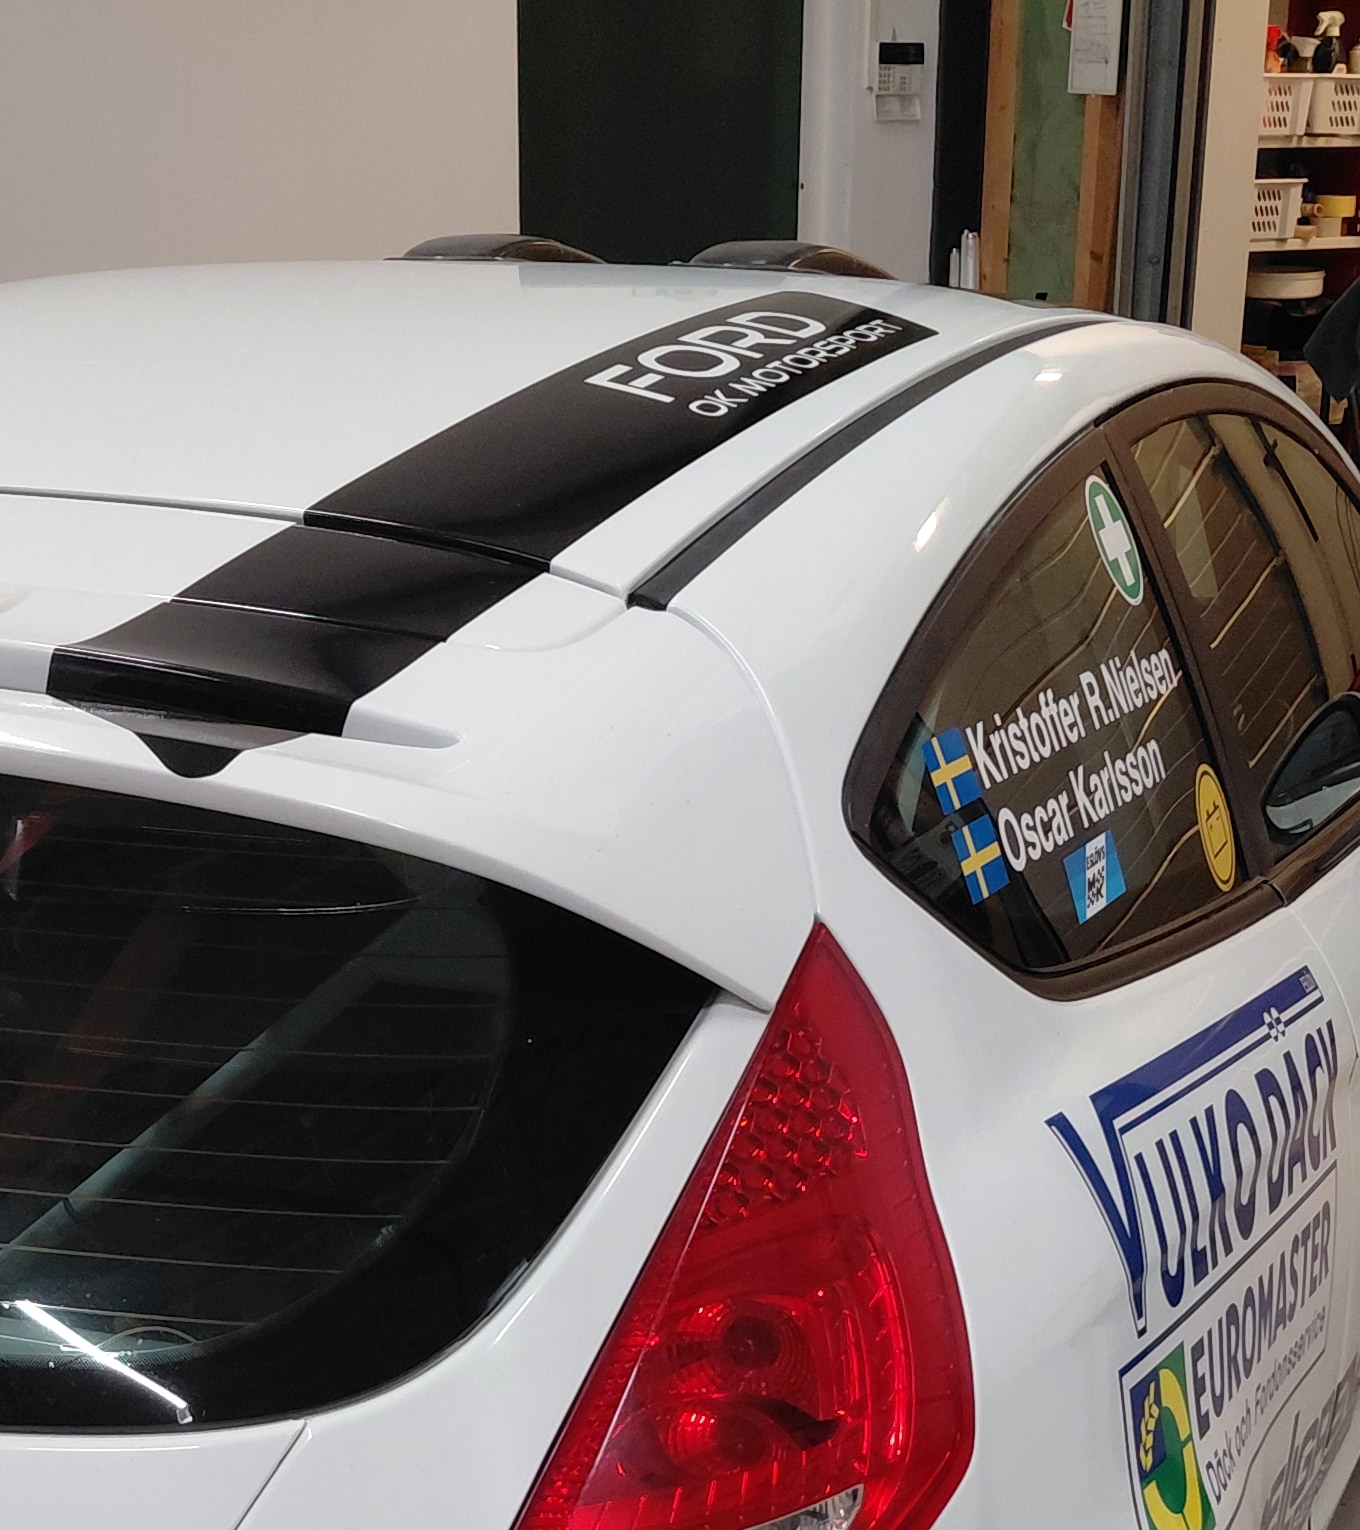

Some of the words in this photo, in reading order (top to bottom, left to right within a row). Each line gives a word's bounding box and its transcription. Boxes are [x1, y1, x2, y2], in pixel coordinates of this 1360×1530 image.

[583, 311, 827, 403] FORD
[689, 389, 749, 417] OK
[728, 319, 903, 397] MOTORSPORT
[965, 688, 1087, 790] Kristoffer
[1079, 648, 1178, 731] R.Nielsen
[997, 790, 1075, 872] Oscar
[1069, 738, 1167, 829] Karlsson
[1044, 1086, 1262, 1339] VULKO
[1190, 1200, 1331, 1441] EUROMASTER
[1205, 1430, 1235, 1507] Däck
